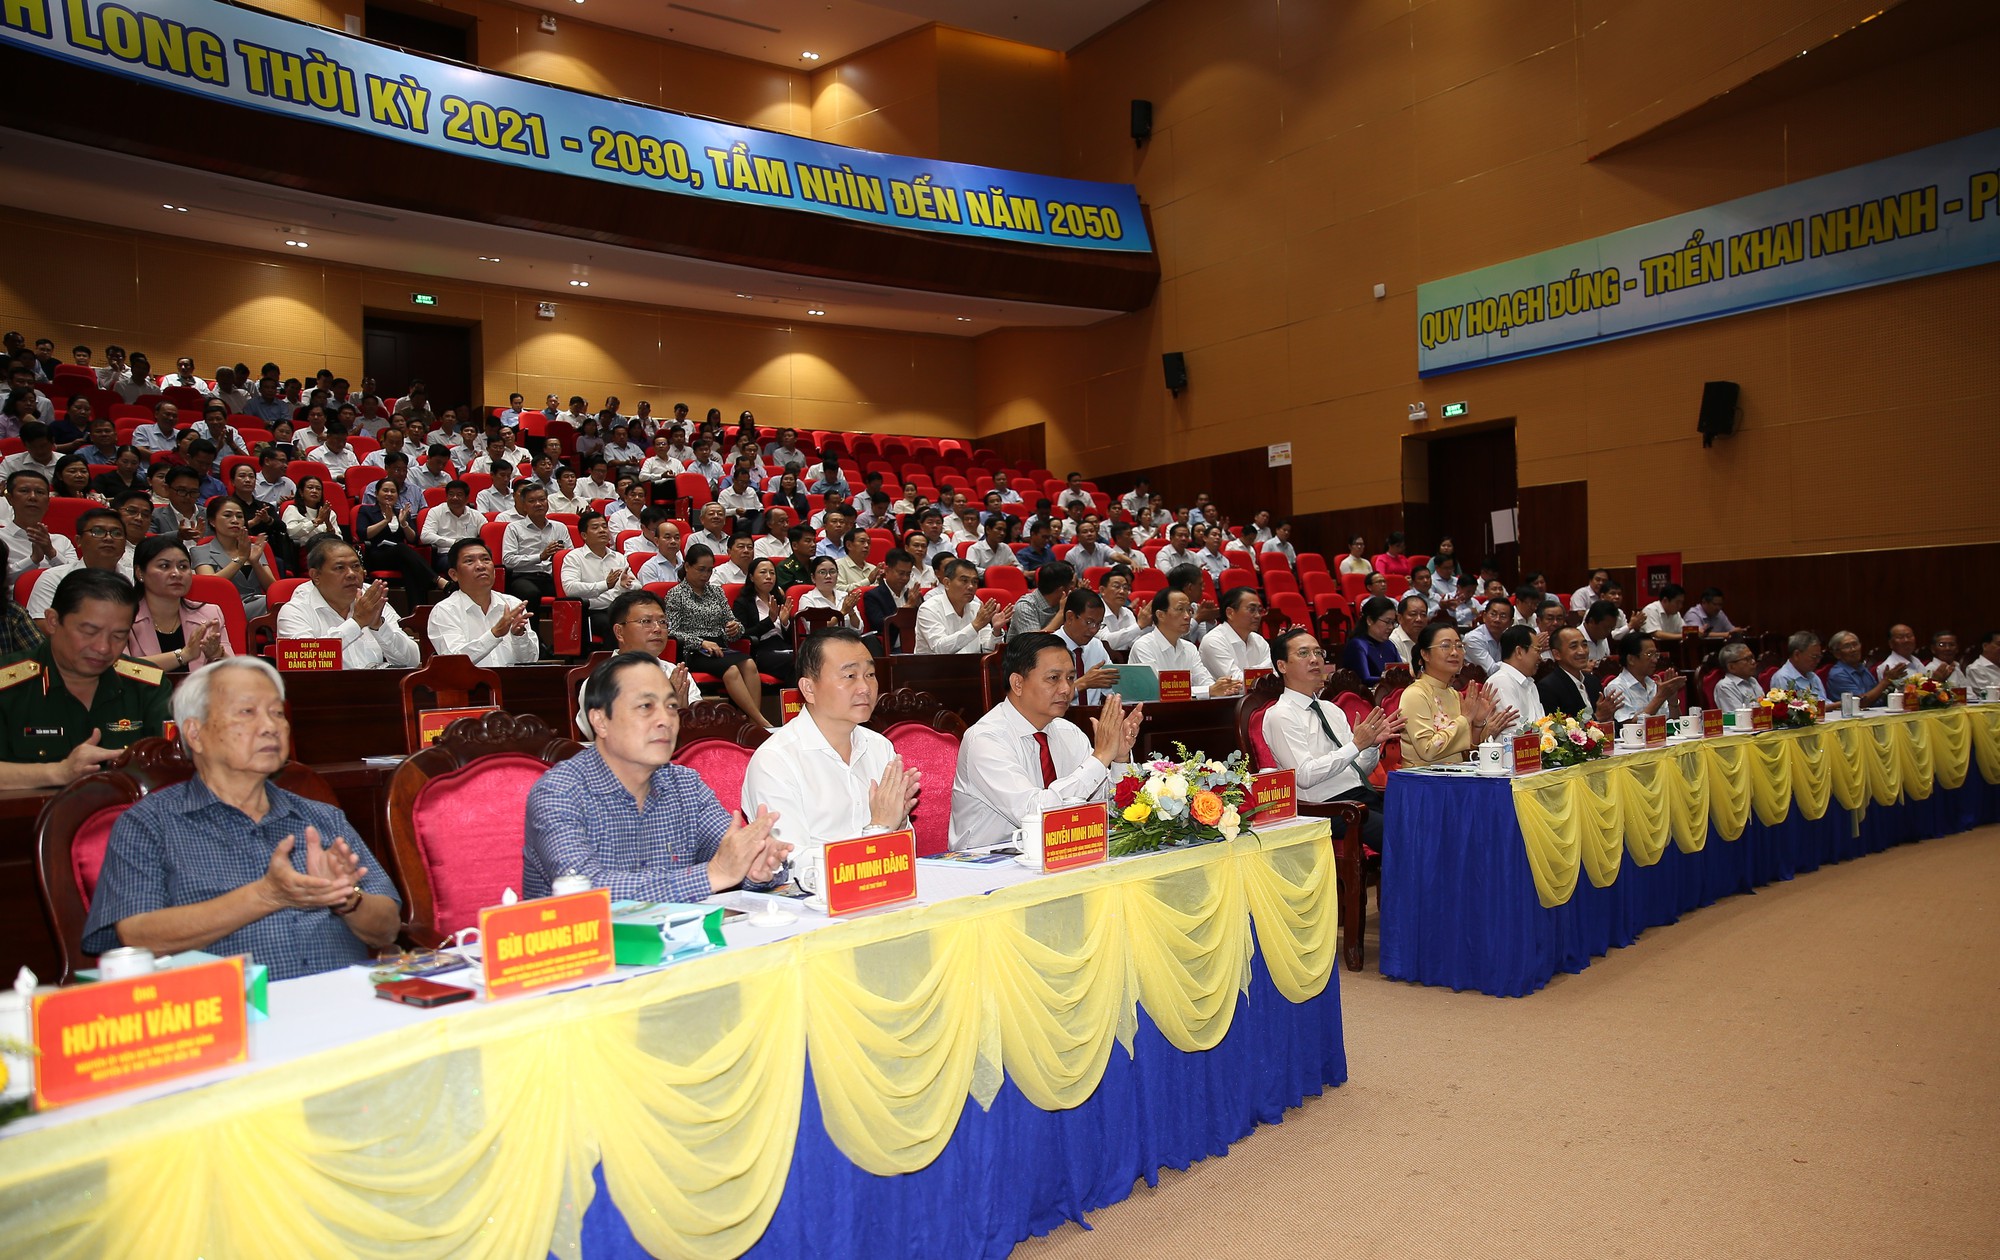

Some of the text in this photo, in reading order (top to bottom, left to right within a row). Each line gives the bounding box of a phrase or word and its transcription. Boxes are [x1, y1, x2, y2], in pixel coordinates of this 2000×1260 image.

[66, 0, 226, 84] LONG
[237, 42, 357, 115] THỜI
[368, 76, 428, 131] KỲ
[444, 97, 549, 156] 2021
[564, 138, 581, 150] -
[591, 128, 702, 188] 2030,
[707, 141, 792, 196] TẦM
[797, 164, 886, 213] NHÌN
[890, 174, 962, 223] ĐẾN
[965, 187, 1043, 233] NĂM
[1046, 201, 1122, 241] 2050
[1420, 169, 2000, 350] QUY HOẠCH ĐÚNG - TRIỂN KHAI NHANH - P
[284, 649, 336, 659] BAN CHẤP HÀNH
[288, 658, 333, 670] ĐẢNG BỘ TỈNH
[1257, 784, 1291, 804] TRẦN VĂN LÂU
[1045, 821, 1104, 847] NGUYỄN MINH DŨNG
[833, 862, 856, 885] LÂM
[856, 858, 882, 880] MINH
[497, 919, 600, 961] BÙI QUANG HUY
[61, 1011, 143, 1057] HUỲNH
[145, 1000, 192, 1038] VĂN
